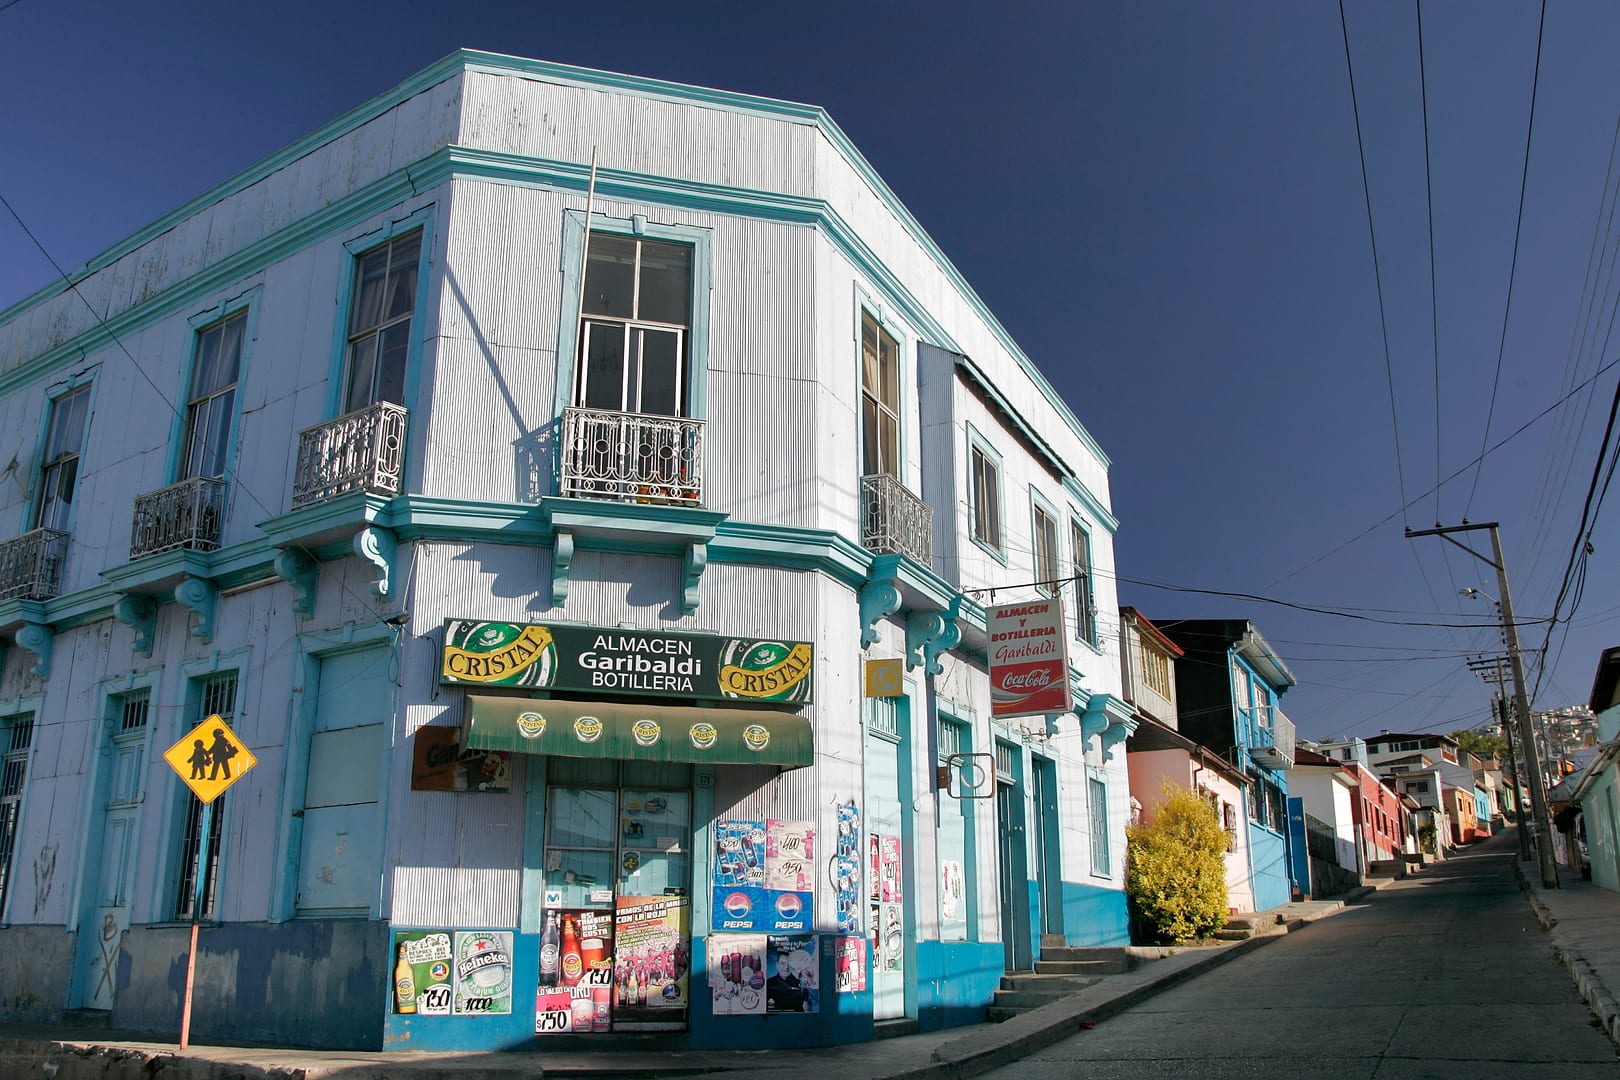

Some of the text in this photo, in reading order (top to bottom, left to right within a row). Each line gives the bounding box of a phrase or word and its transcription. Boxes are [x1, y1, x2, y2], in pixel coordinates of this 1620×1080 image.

[996, 605, 1049, 619] ALMACEN
[1019, 619, 1027, 627] Y
[991, 627, 1056, 642] BOTILLERIA
[593, 636, 692, 655] ALMACEN
[995, 640, 1056, 664] Garibaldi
[448, 634, 544, 677] CRISTAL
[577, 652, 701, 676] Garibaldi
[728, 653, 810, 692] CRISTAL
[1002, 668, 1051, 690] Coca-Cola
[592, 672, 693, 692] BOTILLERIA
[616, 906, 642, 916] VAMOS
[616, 909, 667, 924] CON LA ROJA
[723, 920, 752, 928] PEPSI
[775, 921, 803, 929] PEPSI
[423, 989, 451, 1007] 750
[570, 986, 590, 998] ORO
